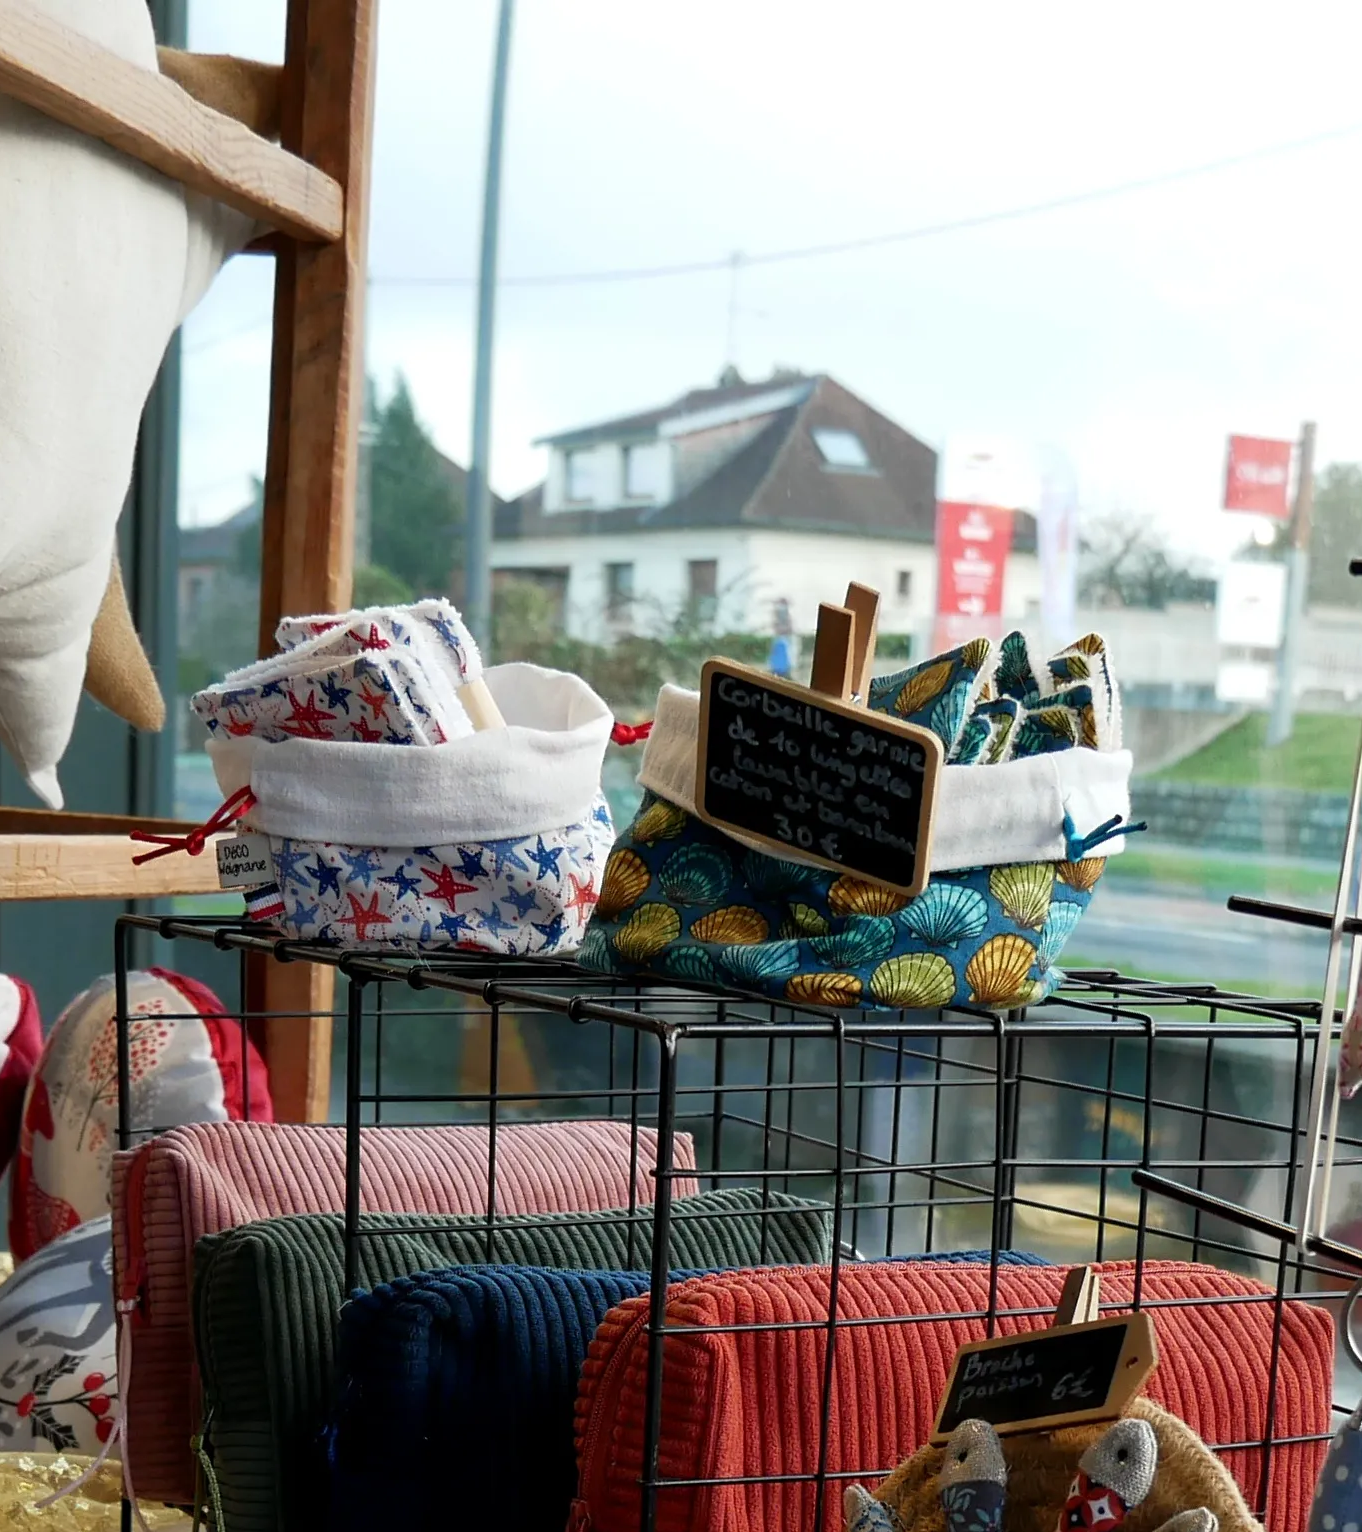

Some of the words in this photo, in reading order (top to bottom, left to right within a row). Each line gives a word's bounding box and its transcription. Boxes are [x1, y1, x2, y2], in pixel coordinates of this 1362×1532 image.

[728, 714, 760, 746] de
[769, 730, 801, 757] 10
[772, 812, 813, 848] 30
[962, 1349, 1036, 1382] Broche
